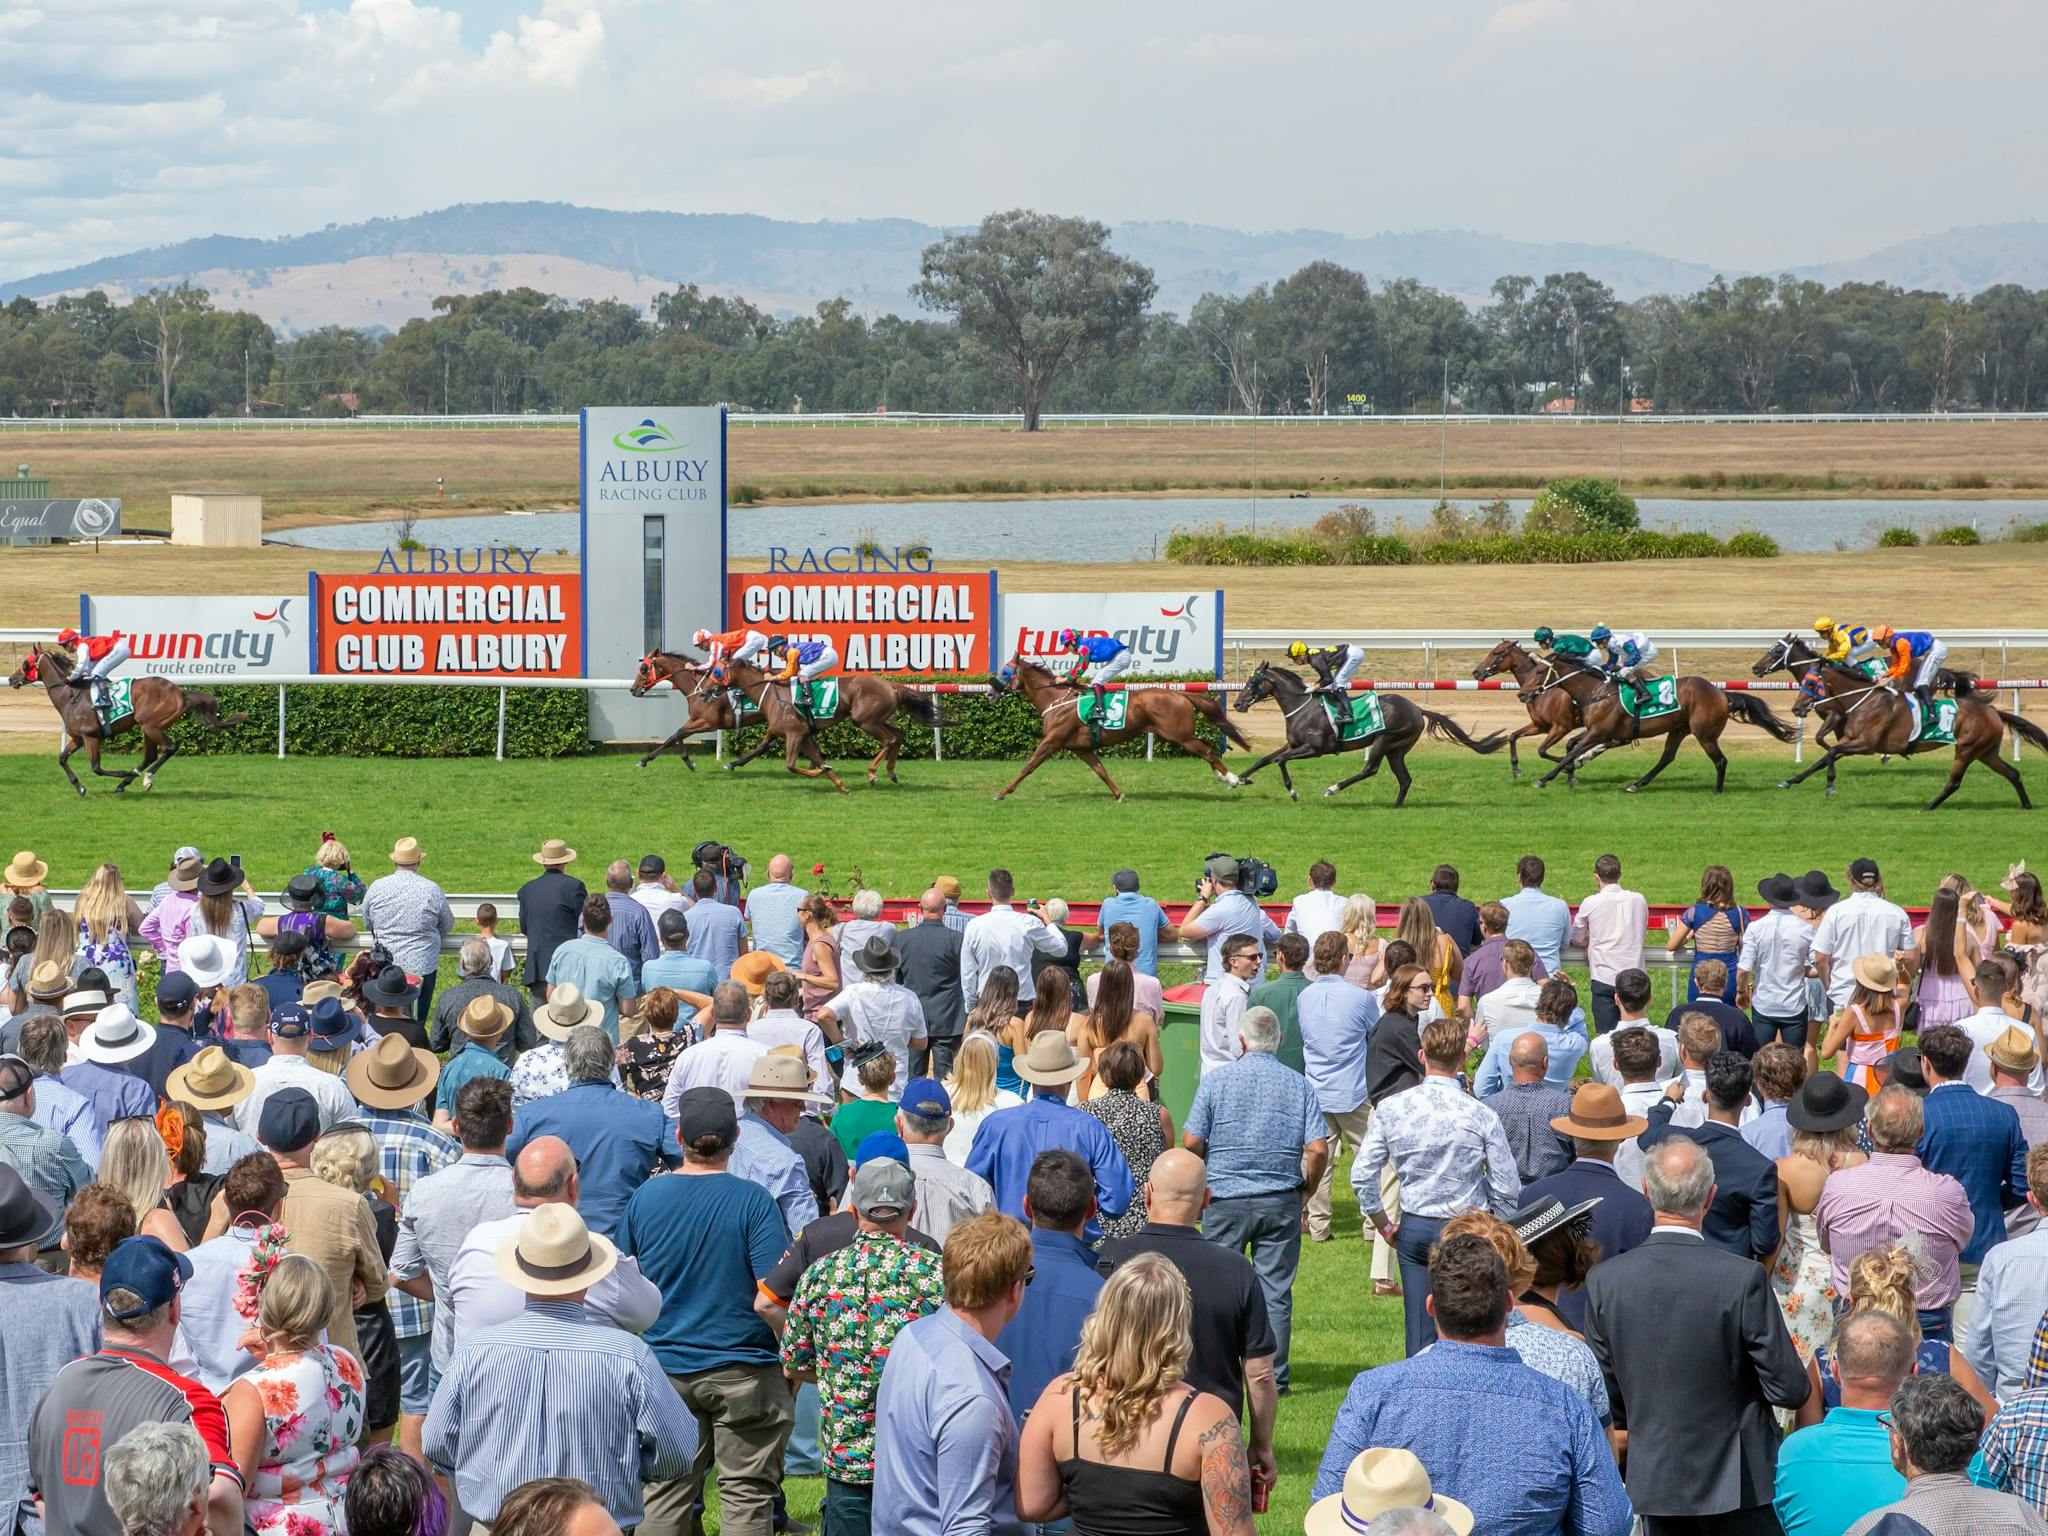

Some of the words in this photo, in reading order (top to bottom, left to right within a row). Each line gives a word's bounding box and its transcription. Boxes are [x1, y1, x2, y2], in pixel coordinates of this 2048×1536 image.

[1346, 394, 1366, 402] 1400
[600, 460, 709, 481] ALBURY
[600, 489, 662, 500] RACING
[668, 489, 707, 500] CLUB
[0, 500, 59, 533] Equal
[371, 545, 543, 574] ALBURY
[767, 547, 934, 574] RACING
[334, 585, 566, 623] COMMERCIAL
[743, 585, 975, 623] COMMERCIAL
[336, 634, 425, 672] CLUB
[435, 634, 567, 672] ALBURY
[844, 633, 976, 672] ALBURY
[146, 662, 185, 674] truck
[189, 662, 236, 674] centre
[820, 681, 836, 708] 7
[1748, 681, 1790, 690] COMMERCIAL
[1997, 680, 2039, 689] COMMERCIAL
[1107, 694, 1124, 720] 5
[1365, 695, 1381, 722] 1
[1938, 704, 1957, 733] 6
